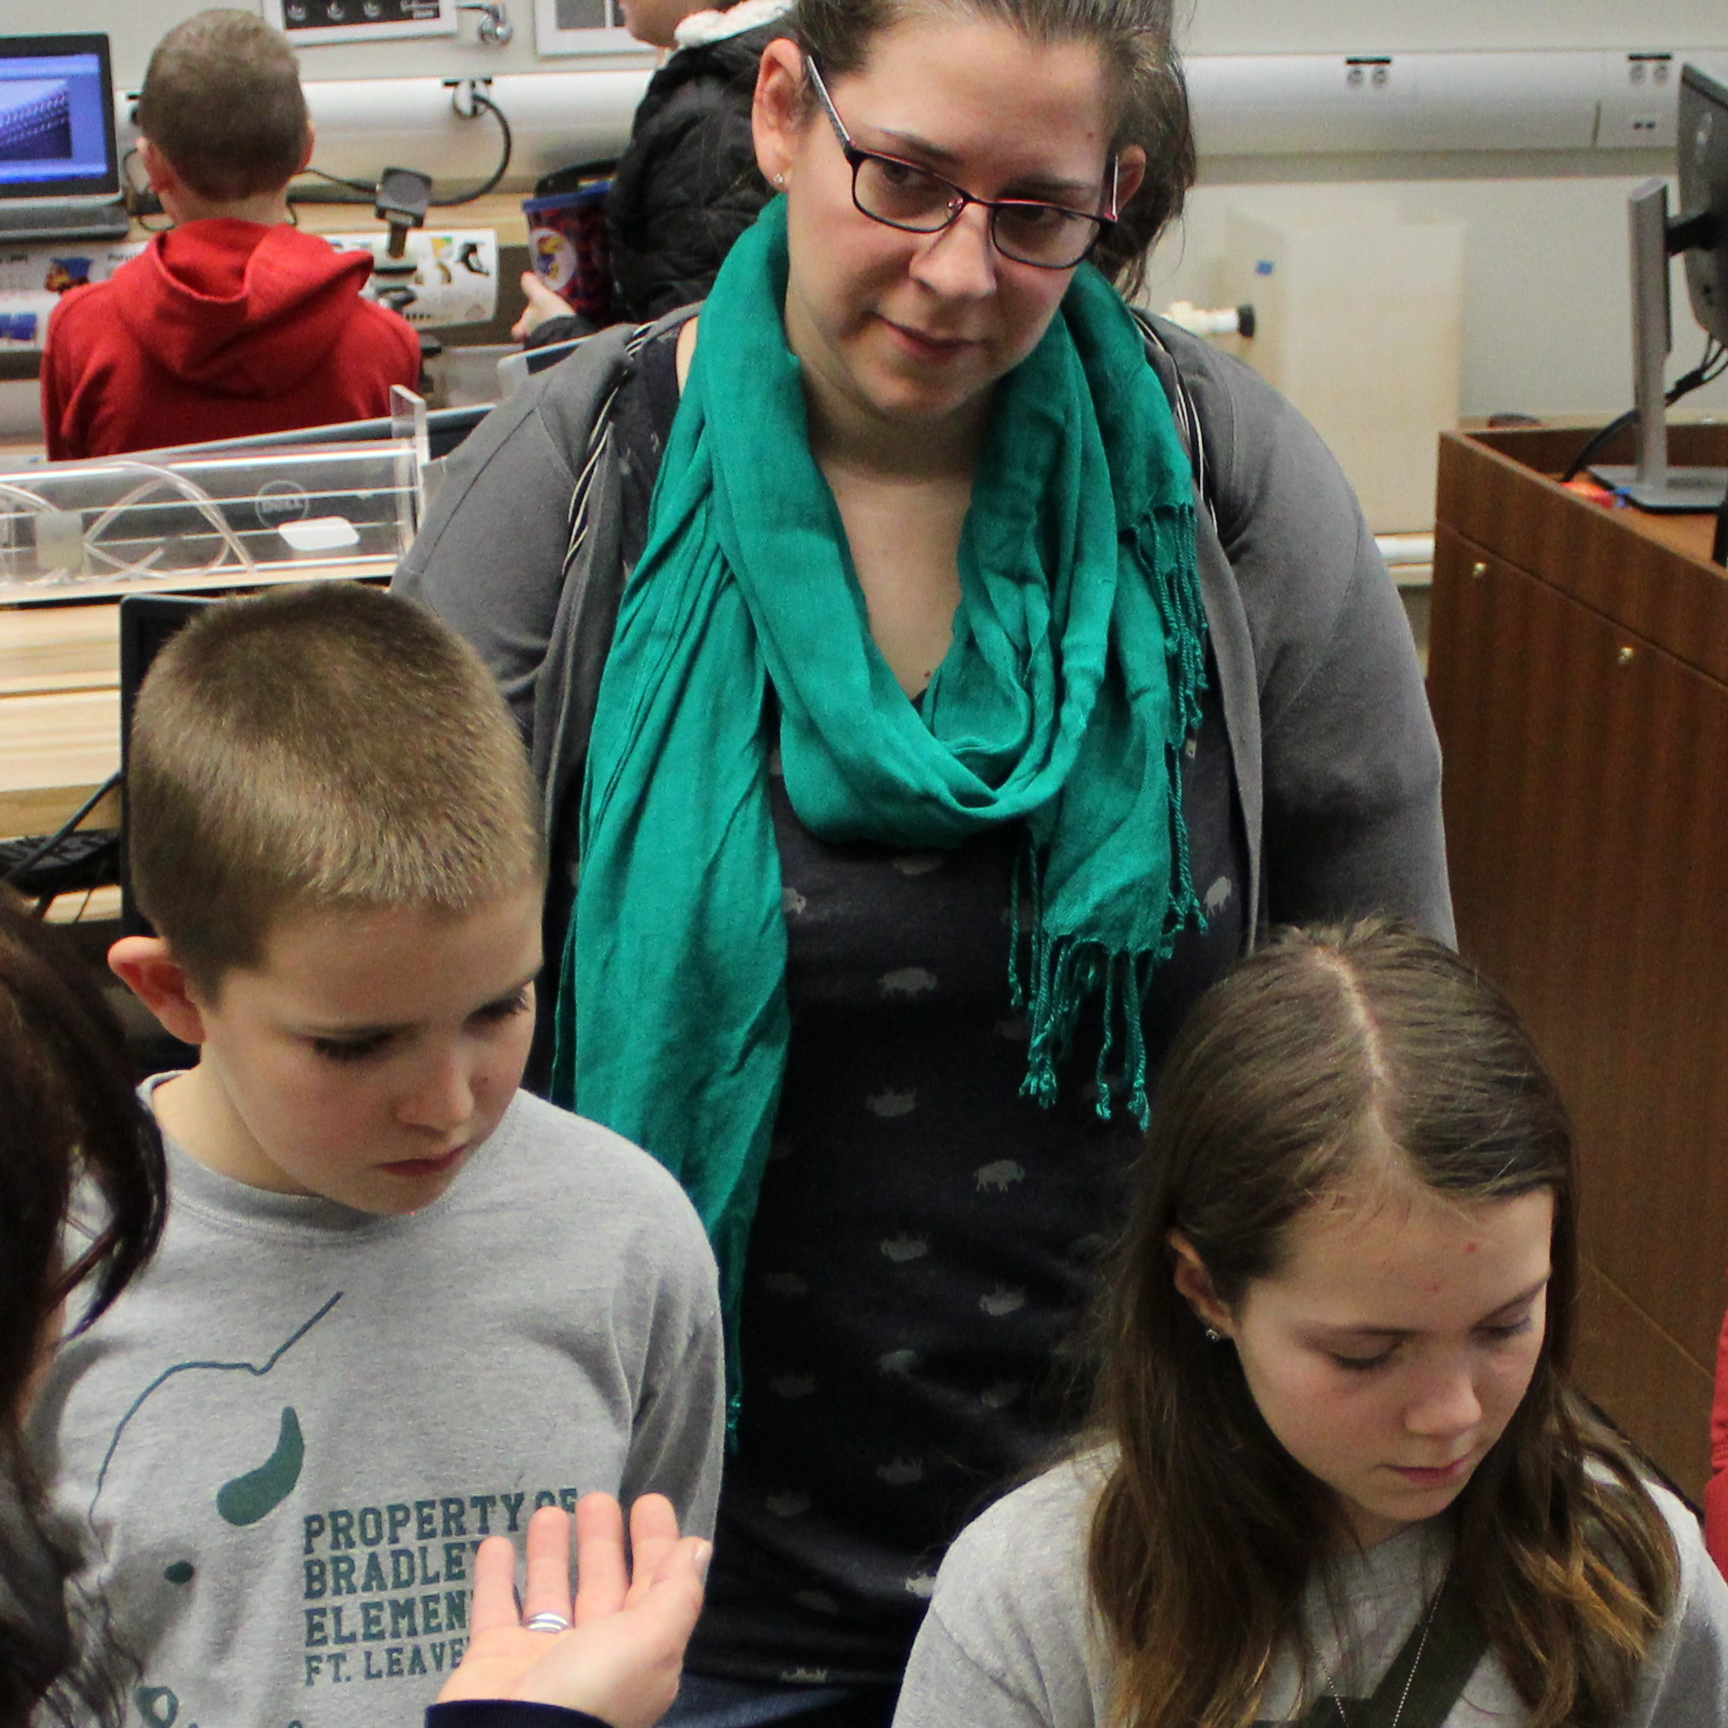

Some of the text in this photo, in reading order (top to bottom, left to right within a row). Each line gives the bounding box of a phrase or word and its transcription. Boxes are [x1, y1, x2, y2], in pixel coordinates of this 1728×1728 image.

[304, 1491, 525, 1555] PROPERTY
[304, 1540, 483, 1601] BRADLE
[305, 1589, 474, 1648] ELEMEN
[305, 1635, 471, 1687] FT. LEAVE
